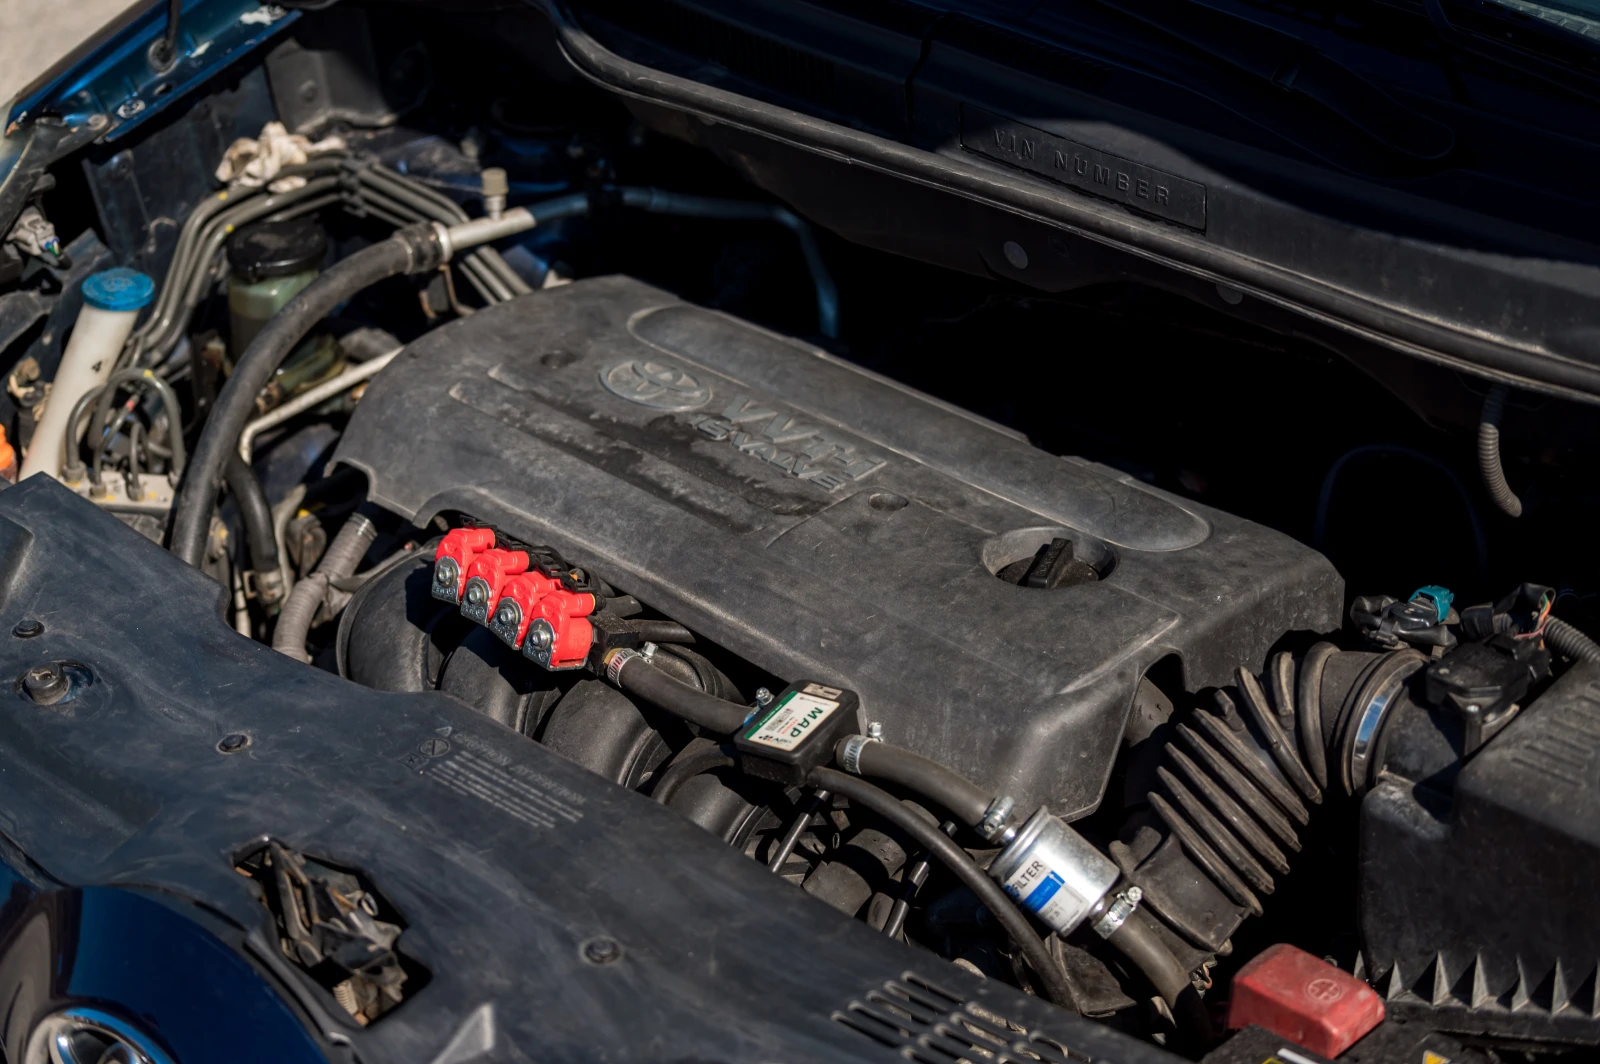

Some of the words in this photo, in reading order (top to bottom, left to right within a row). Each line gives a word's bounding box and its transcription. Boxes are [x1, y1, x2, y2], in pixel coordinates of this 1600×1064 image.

[993, 130, 1035, 160] VIN
[1053, 151, 1170, 205] NUMBER
[731, 430, 847, 494] VALVE
[790, 706, 823, 738] MAP
[1011, 860, 1044, 892] FILTER
